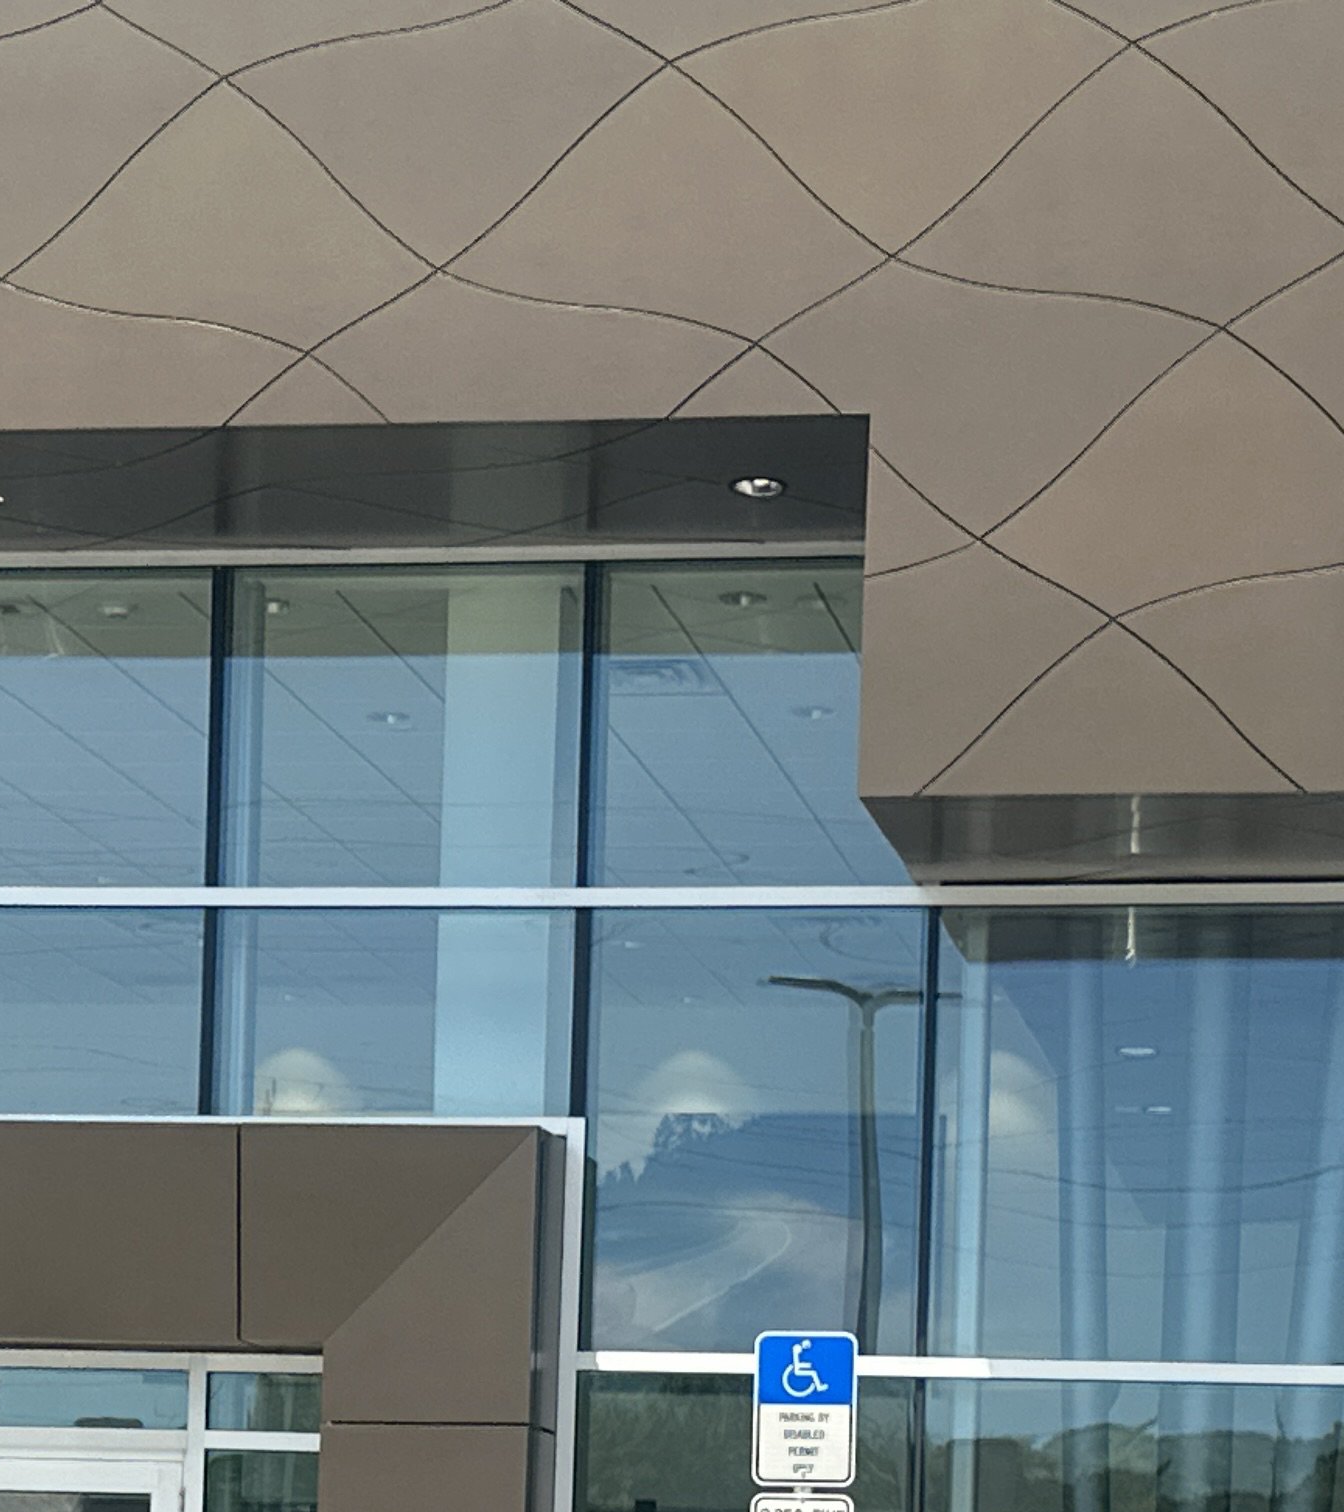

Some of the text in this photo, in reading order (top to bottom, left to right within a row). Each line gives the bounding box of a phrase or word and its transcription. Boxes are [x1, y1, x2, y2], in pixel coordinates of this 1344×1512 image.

[779, 1412, 829, 1423] PARKING BY
[784, 1429, 825, 1439] DISABLED
